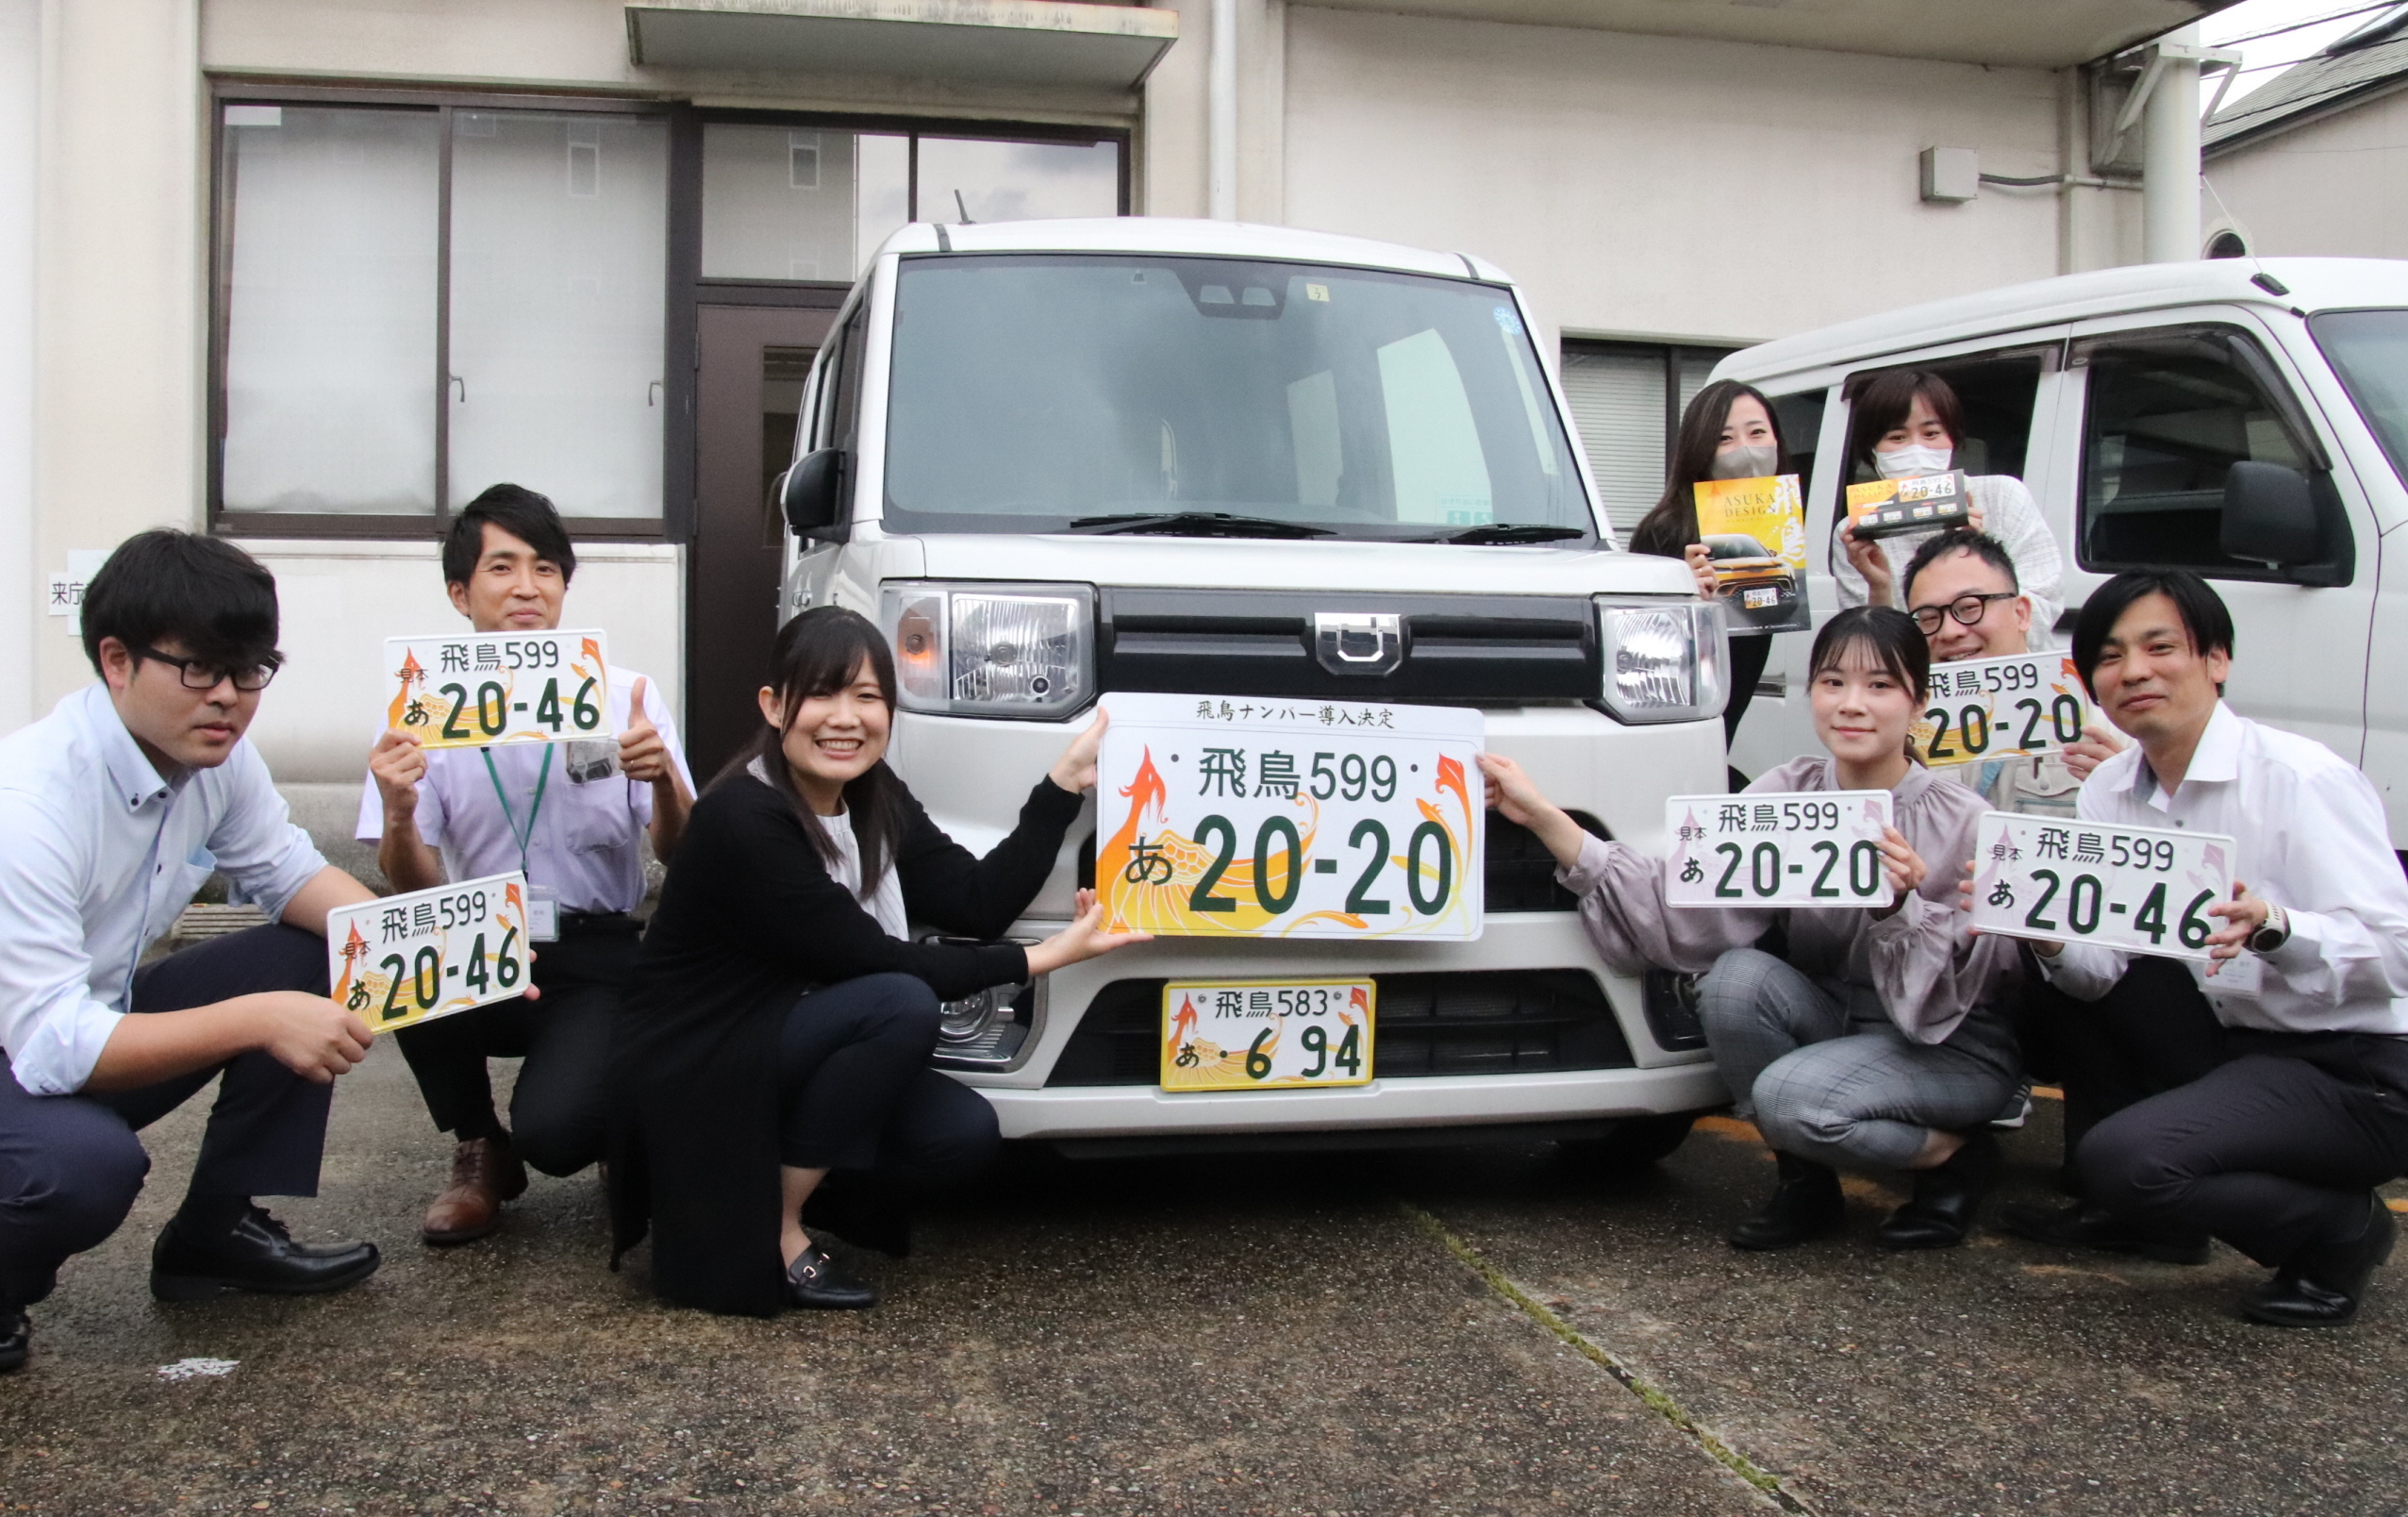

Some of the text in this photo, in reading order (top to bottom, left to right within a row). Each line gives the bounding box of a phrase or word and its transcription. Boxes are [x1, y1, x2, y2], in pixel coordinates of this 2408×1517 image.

[1724, 492, 1775, 507] ASUKA
[1911, 482, 1952, 499] 20-46
[1725, 505, 1777, 517] DESIGN
[52, 581, 87, 605] 来庁
[1752, 595, 1776, 607] 20-46
[441, 641, 559, 673] 飛鳥599
[400, 668, 429, 683] 見本
[1928, 663, 2038, 698] 飛鳥599
[404, 676, 600, 739] あ 20-46
[1197, 700, 1394, 729] 飛鳥ナンバー導入決定
[1924, 693, 2082, 758] 20-20
[1198, 747, 1397, 802] 飛鳥599
[1719, 802, 1838, 832] 飛鳥599
[1680, 826, 1707, 841] 見本
[1125, 814, 1451, 915] あ 20-20
[1991, 844, 2022, 861] 見本
[2036, 827, 2174, 872] 飛鳥599
[1680, 840, 1879, 897] あ 20-20
[381, 891, 487, 943] 飛鳥599
[1987, 869, 2216, 949] あ 20-46
[344, 941, 371, 961] 見本
[347, 925, 520, 1021] あ 20-46
[1216, 990, 1328, 1018] 飛鳥583
